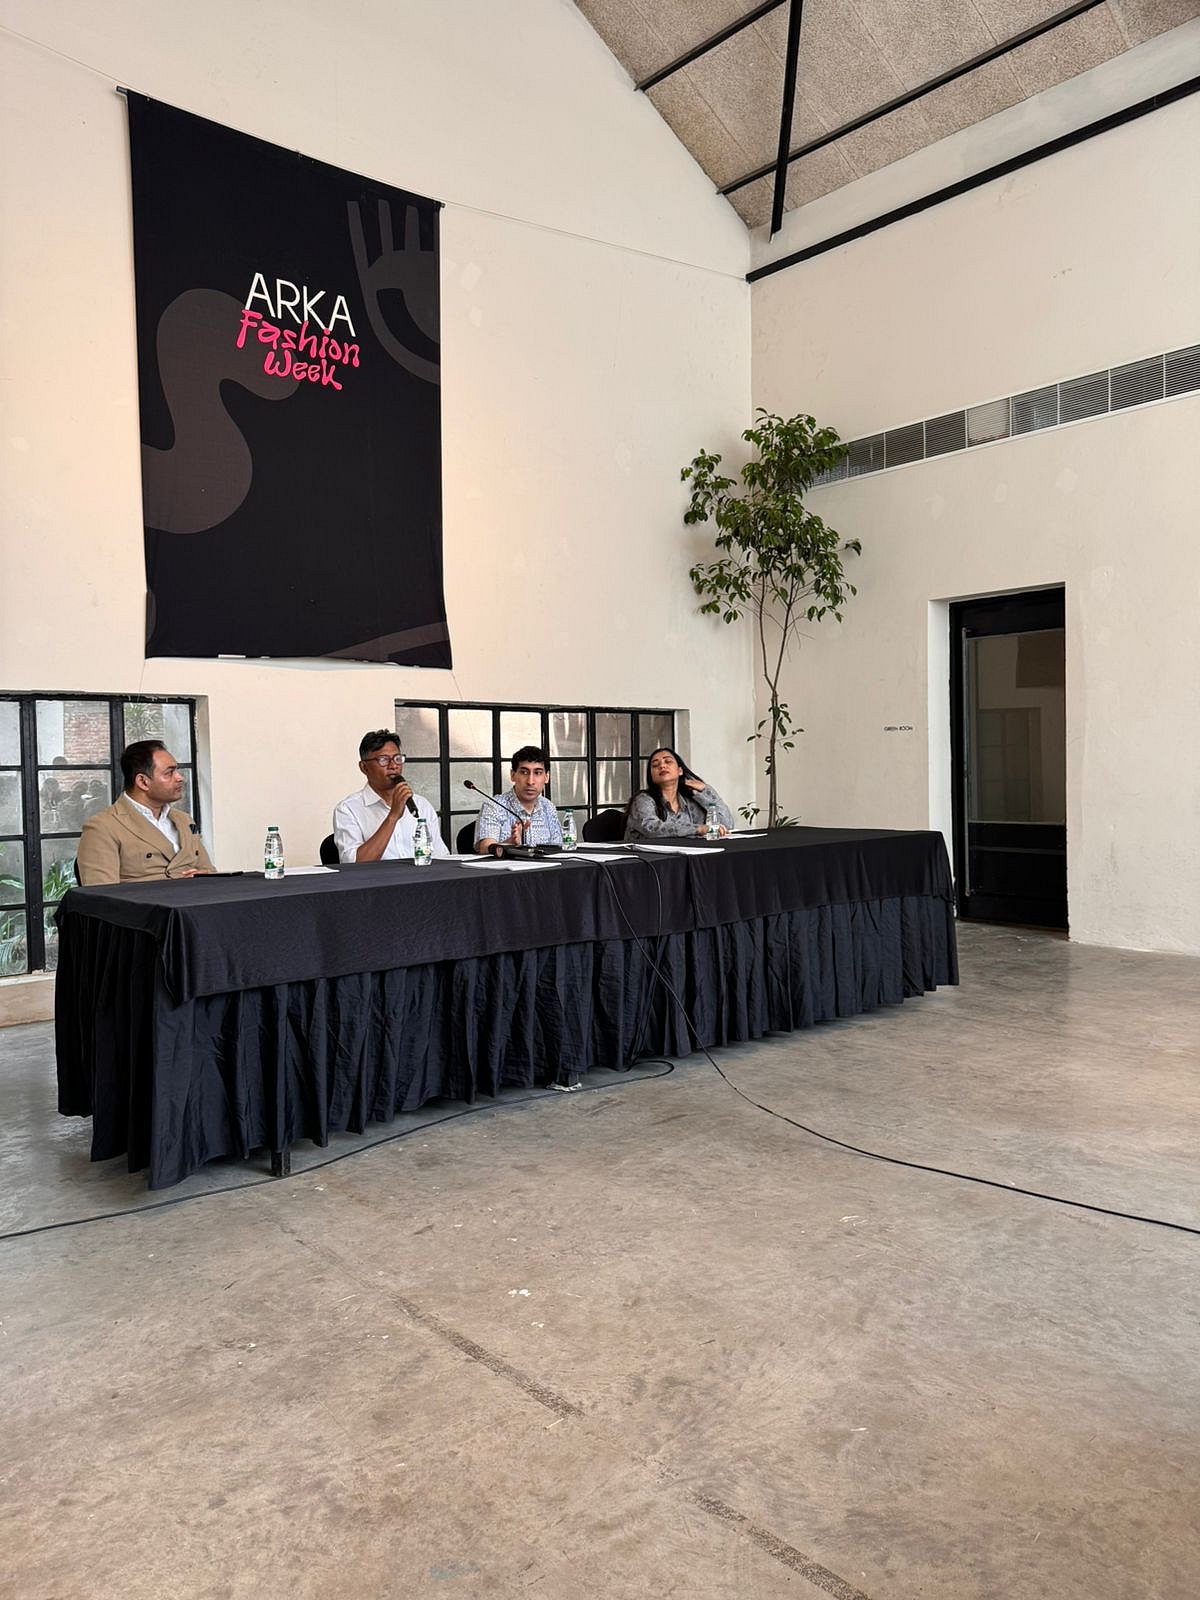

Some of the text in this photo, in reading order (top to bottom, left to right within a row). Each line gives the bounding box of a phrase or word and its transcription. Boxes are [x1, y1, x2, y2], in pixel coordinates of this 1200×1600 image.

[245, 272, 356, 337] ARKA
[236, 309, 360, 368] Fashion
[264, 349, 343, 390] Week
